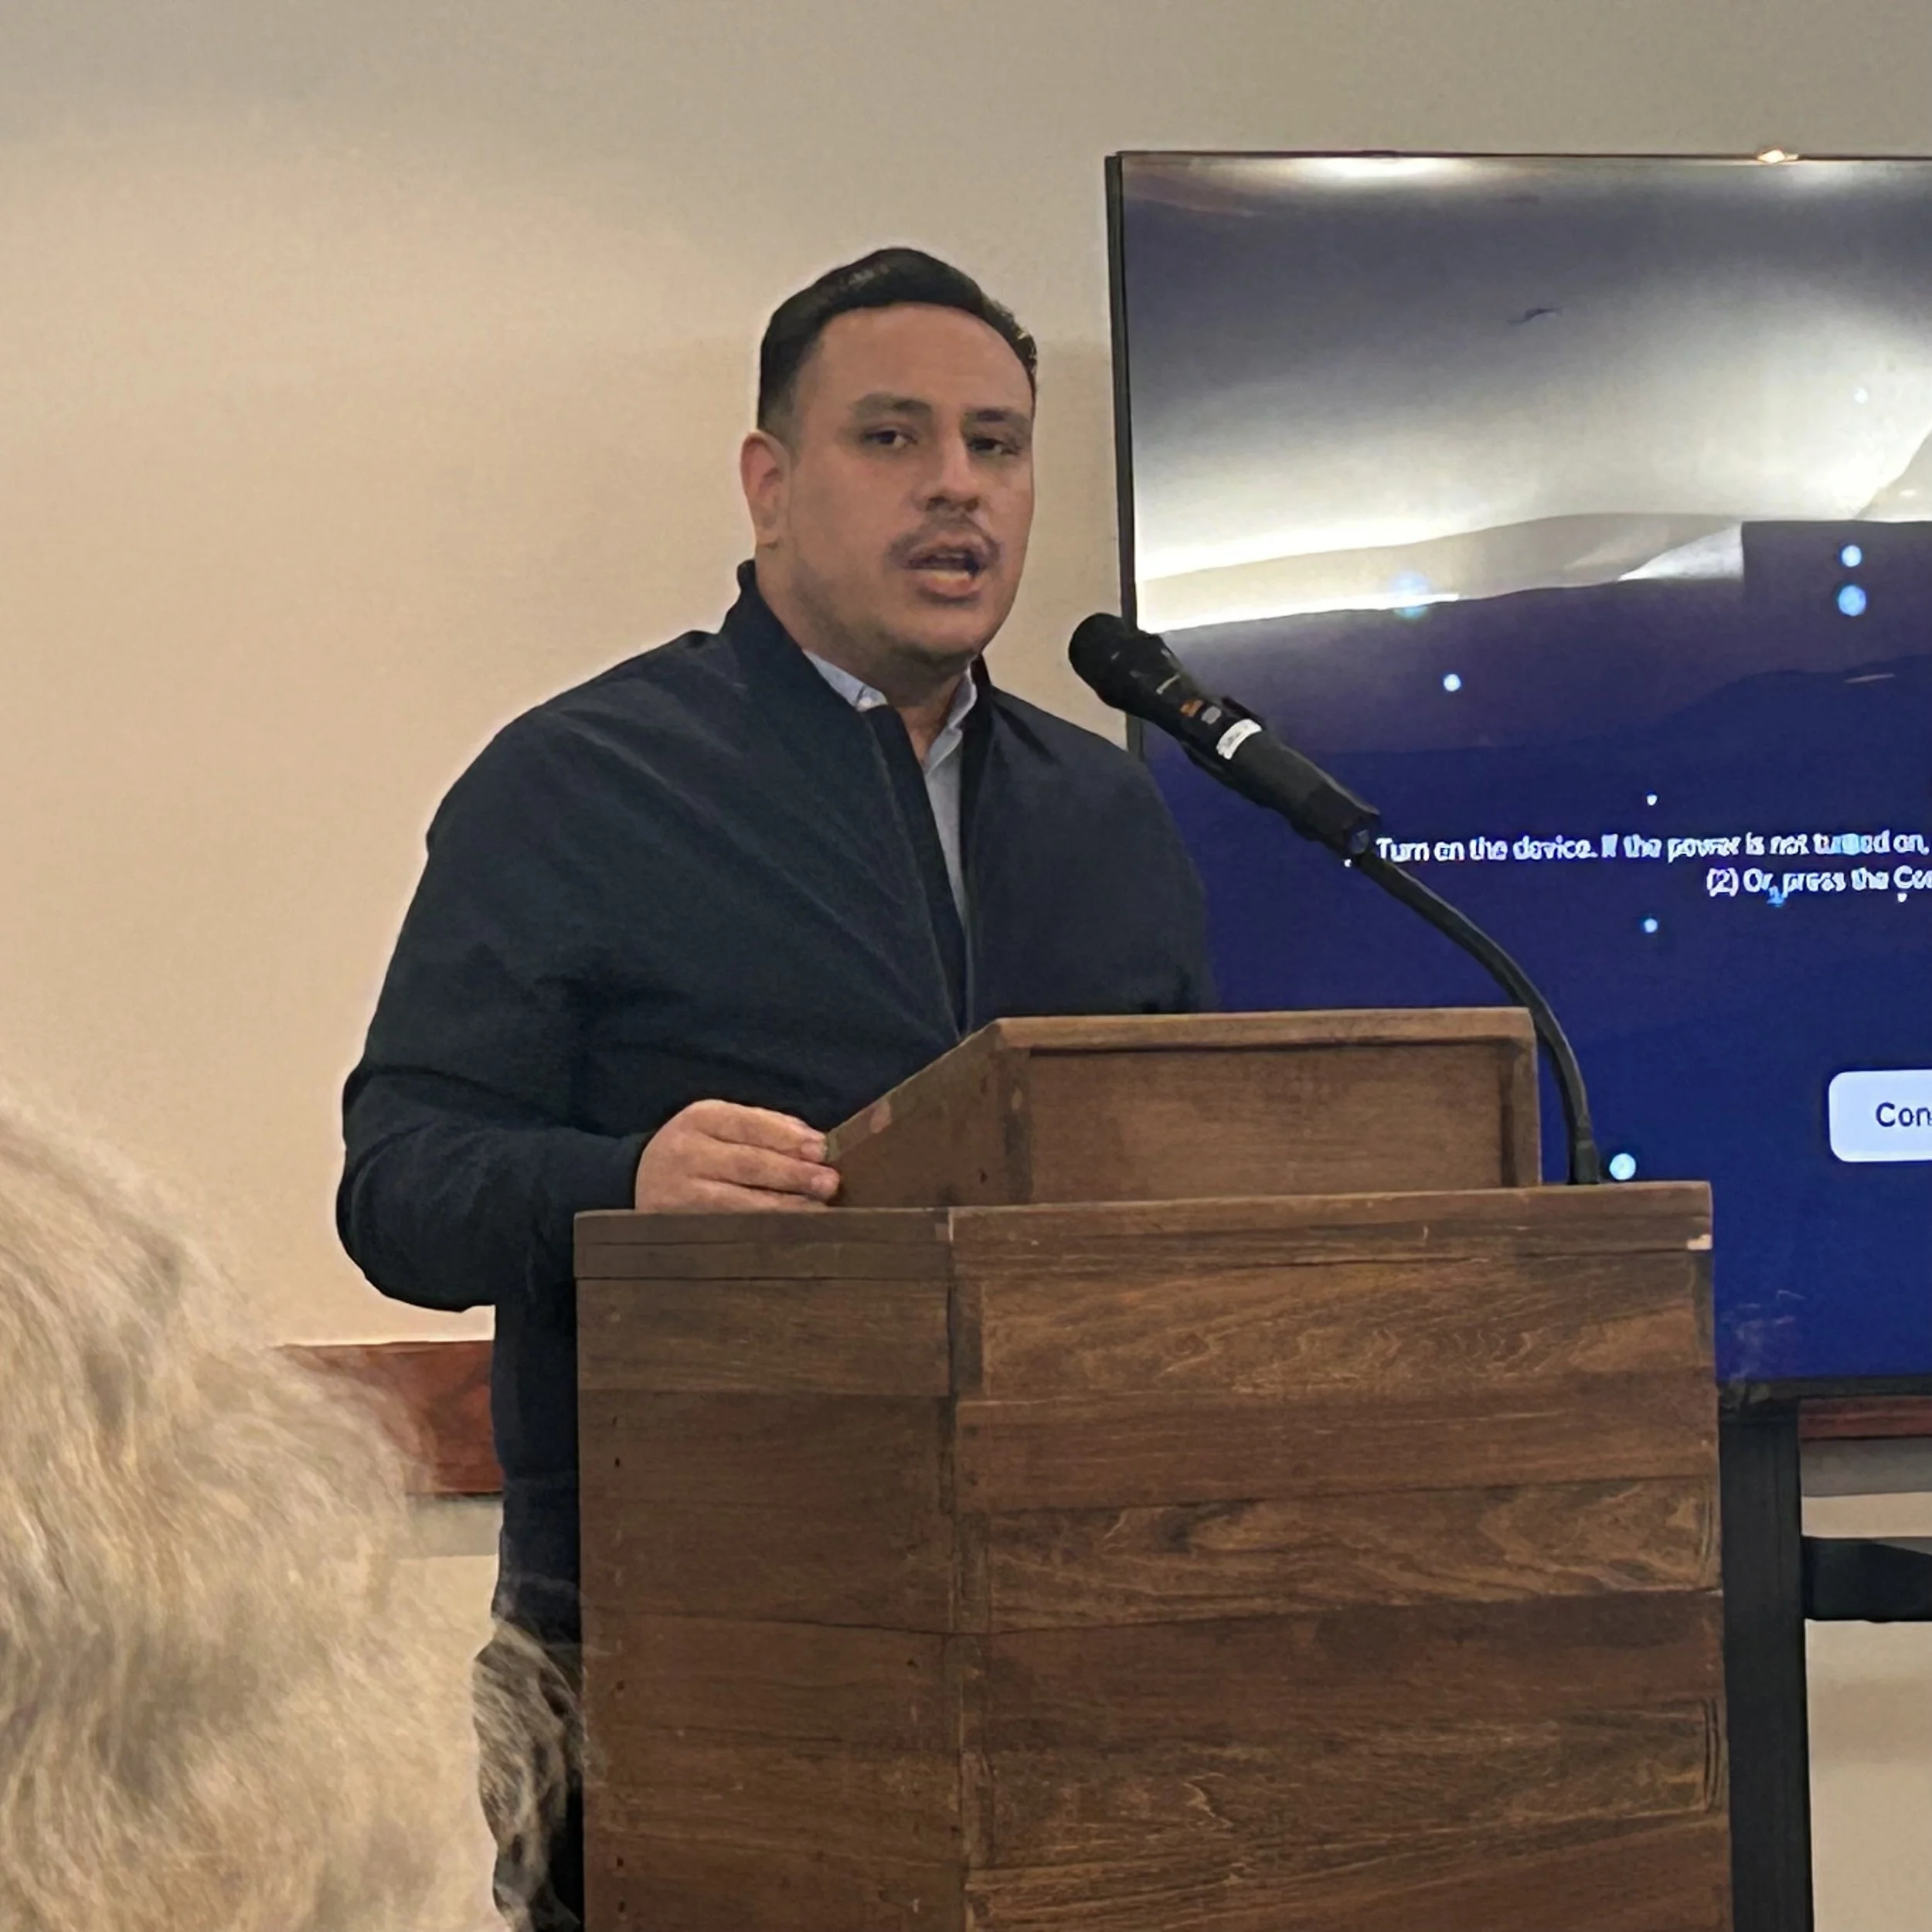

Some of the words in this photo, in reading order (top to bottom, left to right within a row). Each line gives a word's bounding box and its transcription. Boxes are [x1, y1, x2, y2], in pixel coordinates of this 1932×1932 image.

[1376, 838, 1430, 862] Turn
[1434, 842, 1465, 862] on
[1470, 837, 1507, 861] the
[1624, 834, 1662, 858] the
[1668, 837, 1741, 863] power
[1746, 832, 1764, 855] is
[1770, 834, 1809, 855] not
[1706, 868, 1739, 897] (2)
[1783, 872, 1846, 899] press
[1851, 866, 1889, 891] the
